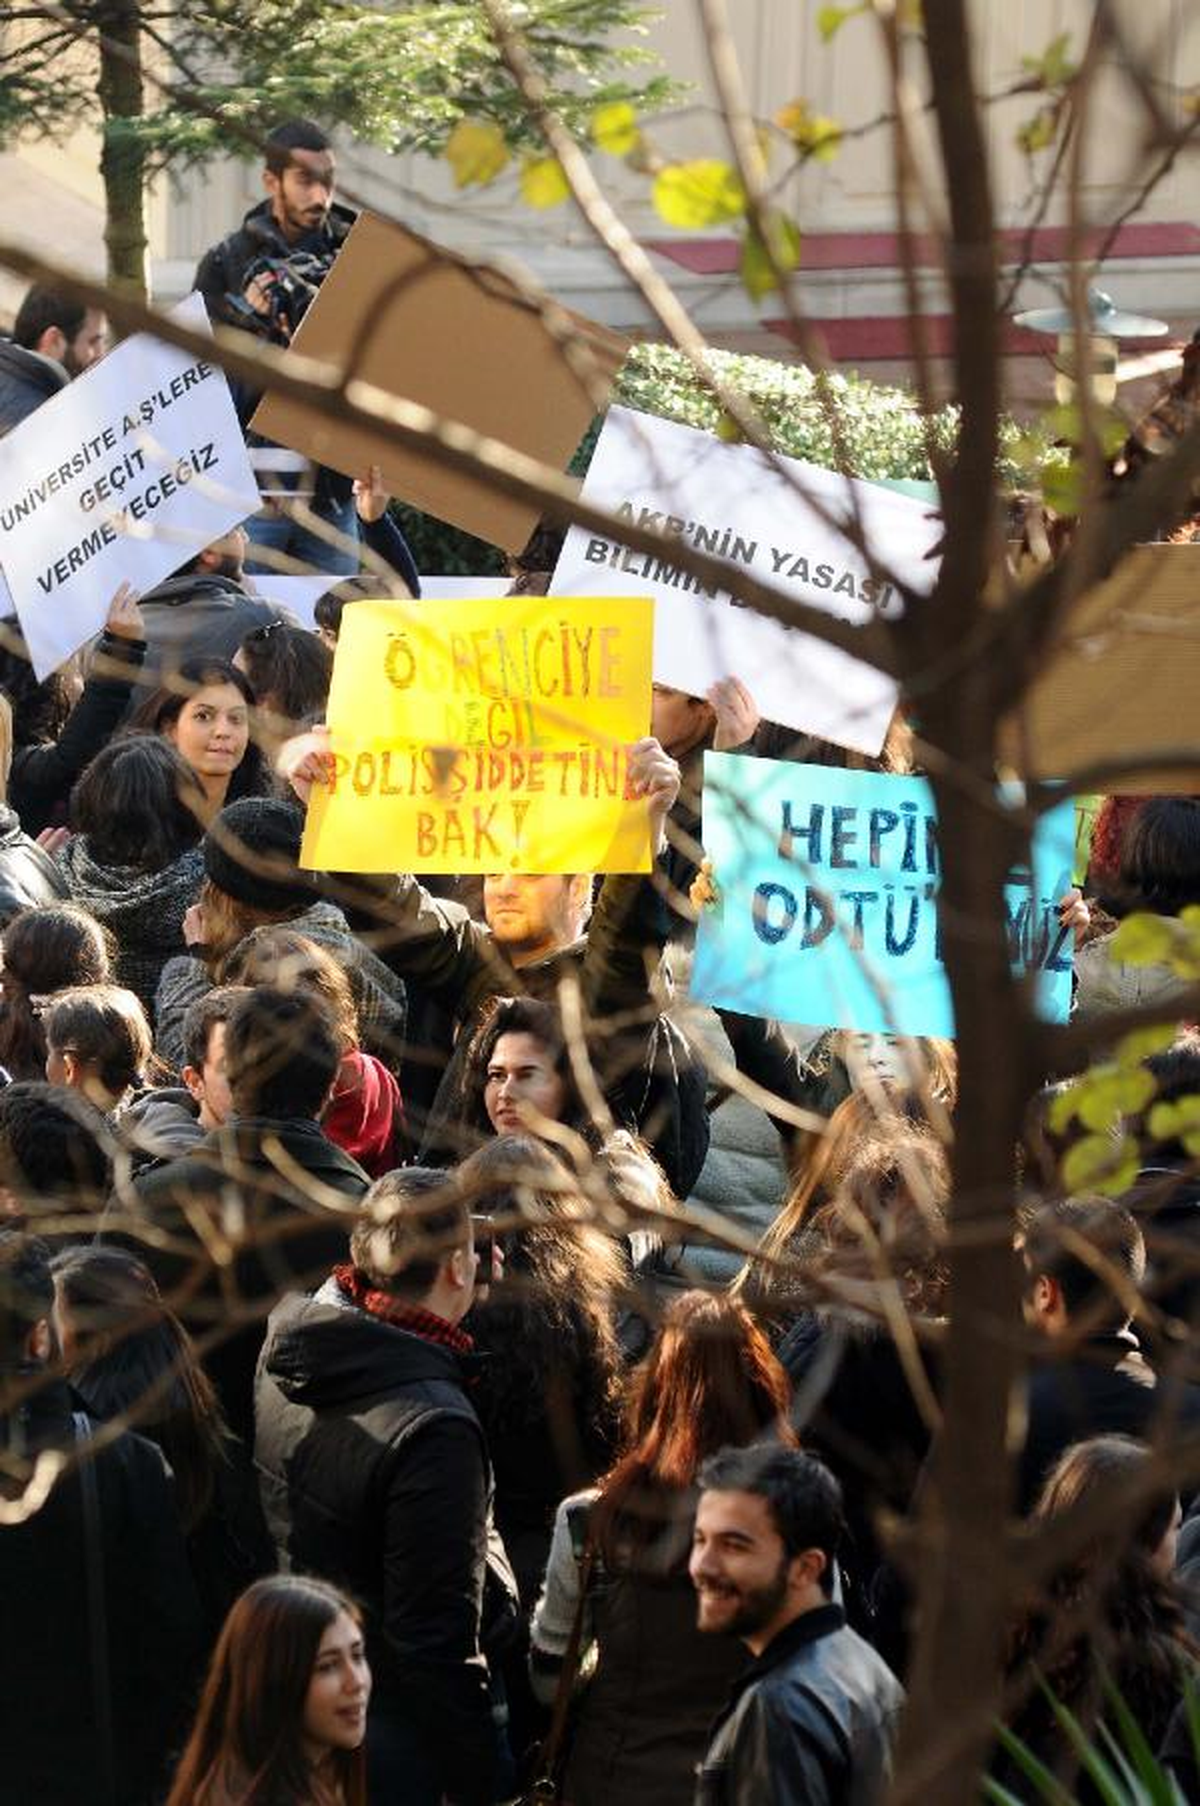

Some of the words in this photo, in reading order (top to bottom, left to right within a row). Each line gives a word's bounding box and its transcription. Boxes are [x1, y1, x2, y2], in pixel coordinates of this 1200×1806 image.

[79, 448, 146, 512] GEÇİT
[37, 443, 219, 594] VERMEECEĞİZ
[771, 547, 893, 609] YASASI
[384, 620, 621, 700] ÖRENCİYE
[778, 800, 940, 875] HEPİ
